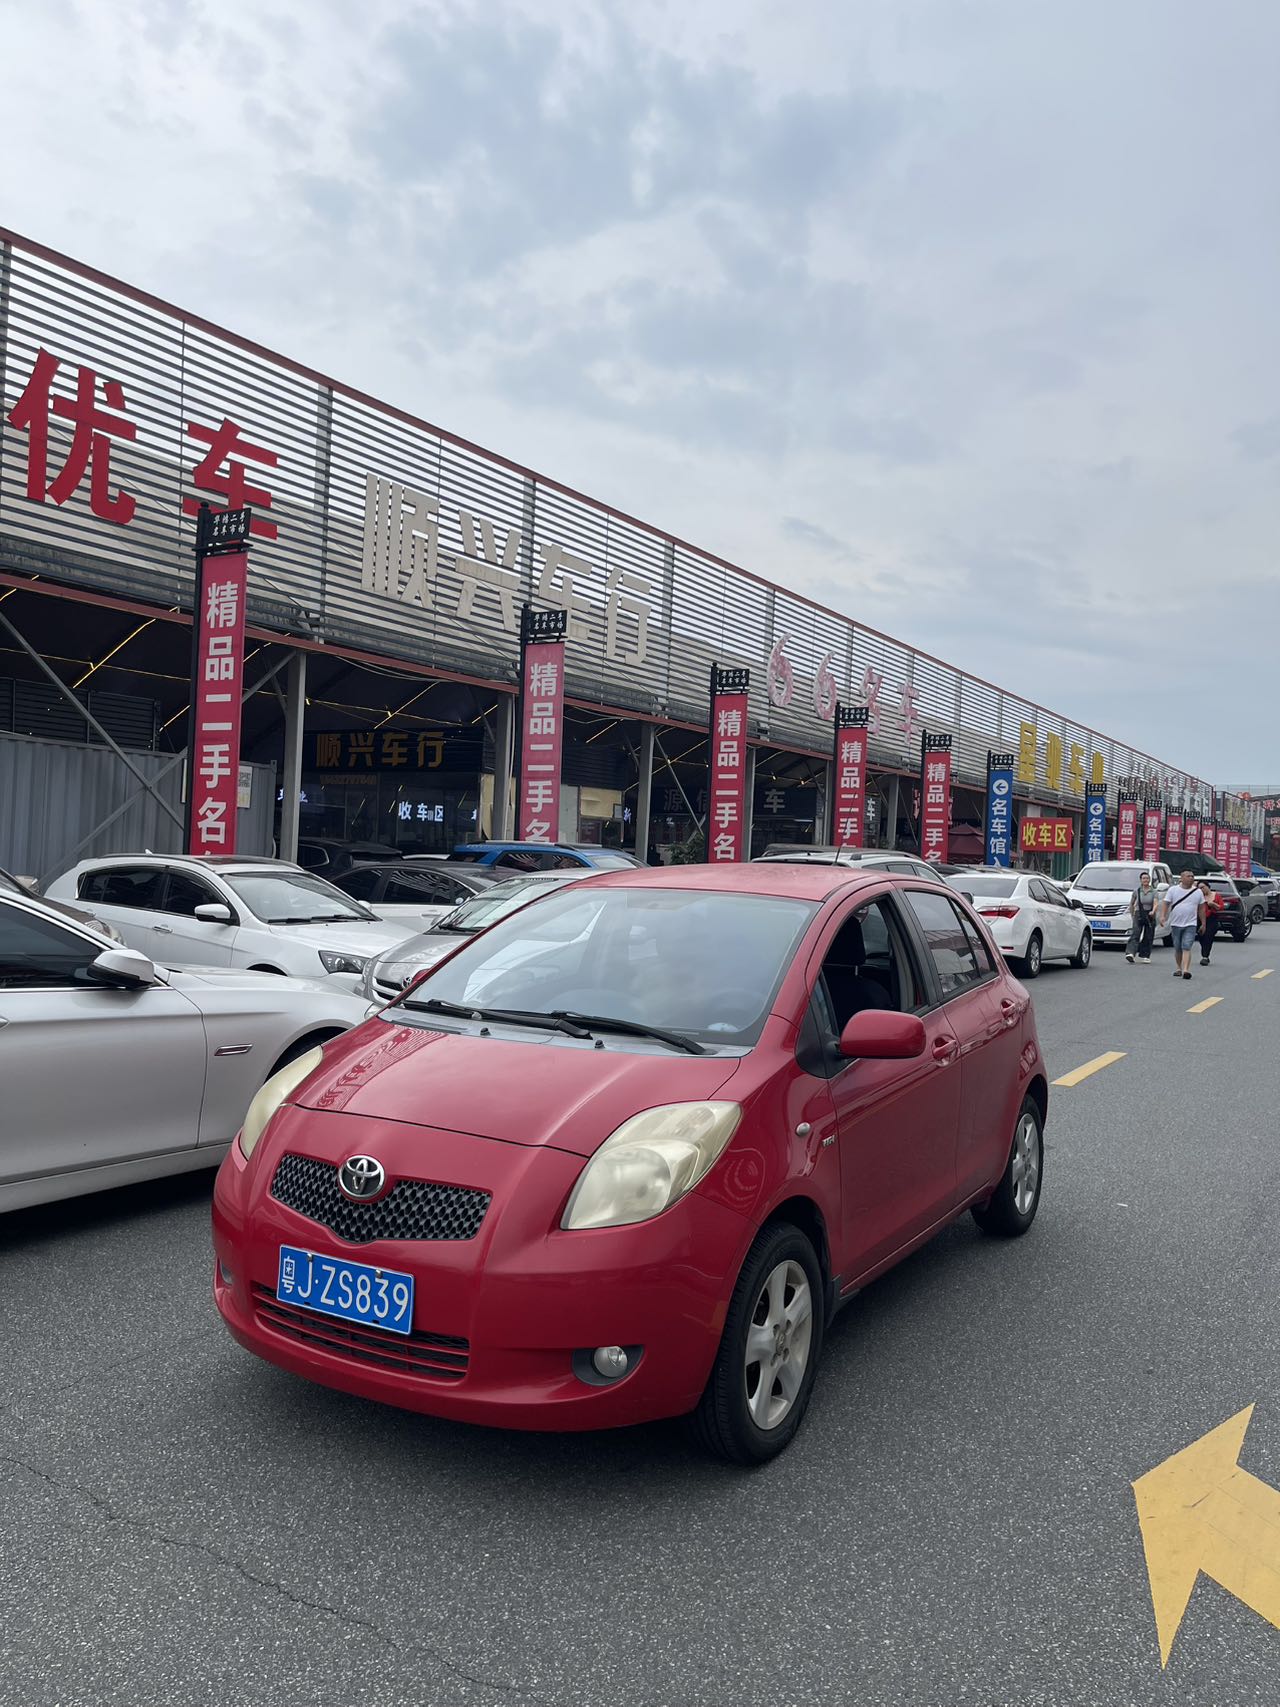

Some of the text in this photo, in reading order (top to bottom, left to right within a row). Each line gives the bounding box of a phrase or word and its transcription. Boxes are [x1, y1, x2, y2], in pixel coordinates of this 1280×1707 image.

[7, 346, 277, 540] 优车
[361, 472, 651, 665] 顺兴车行
[197, 581, 240, 855] 精品二手名
[315, 731, 446, 768] 顺兴车行
[714, 709, 742, 860] 精品二手名
[398, 801, 443, 822] 收车区
[1022, 822, 1068, 847] 收车区
